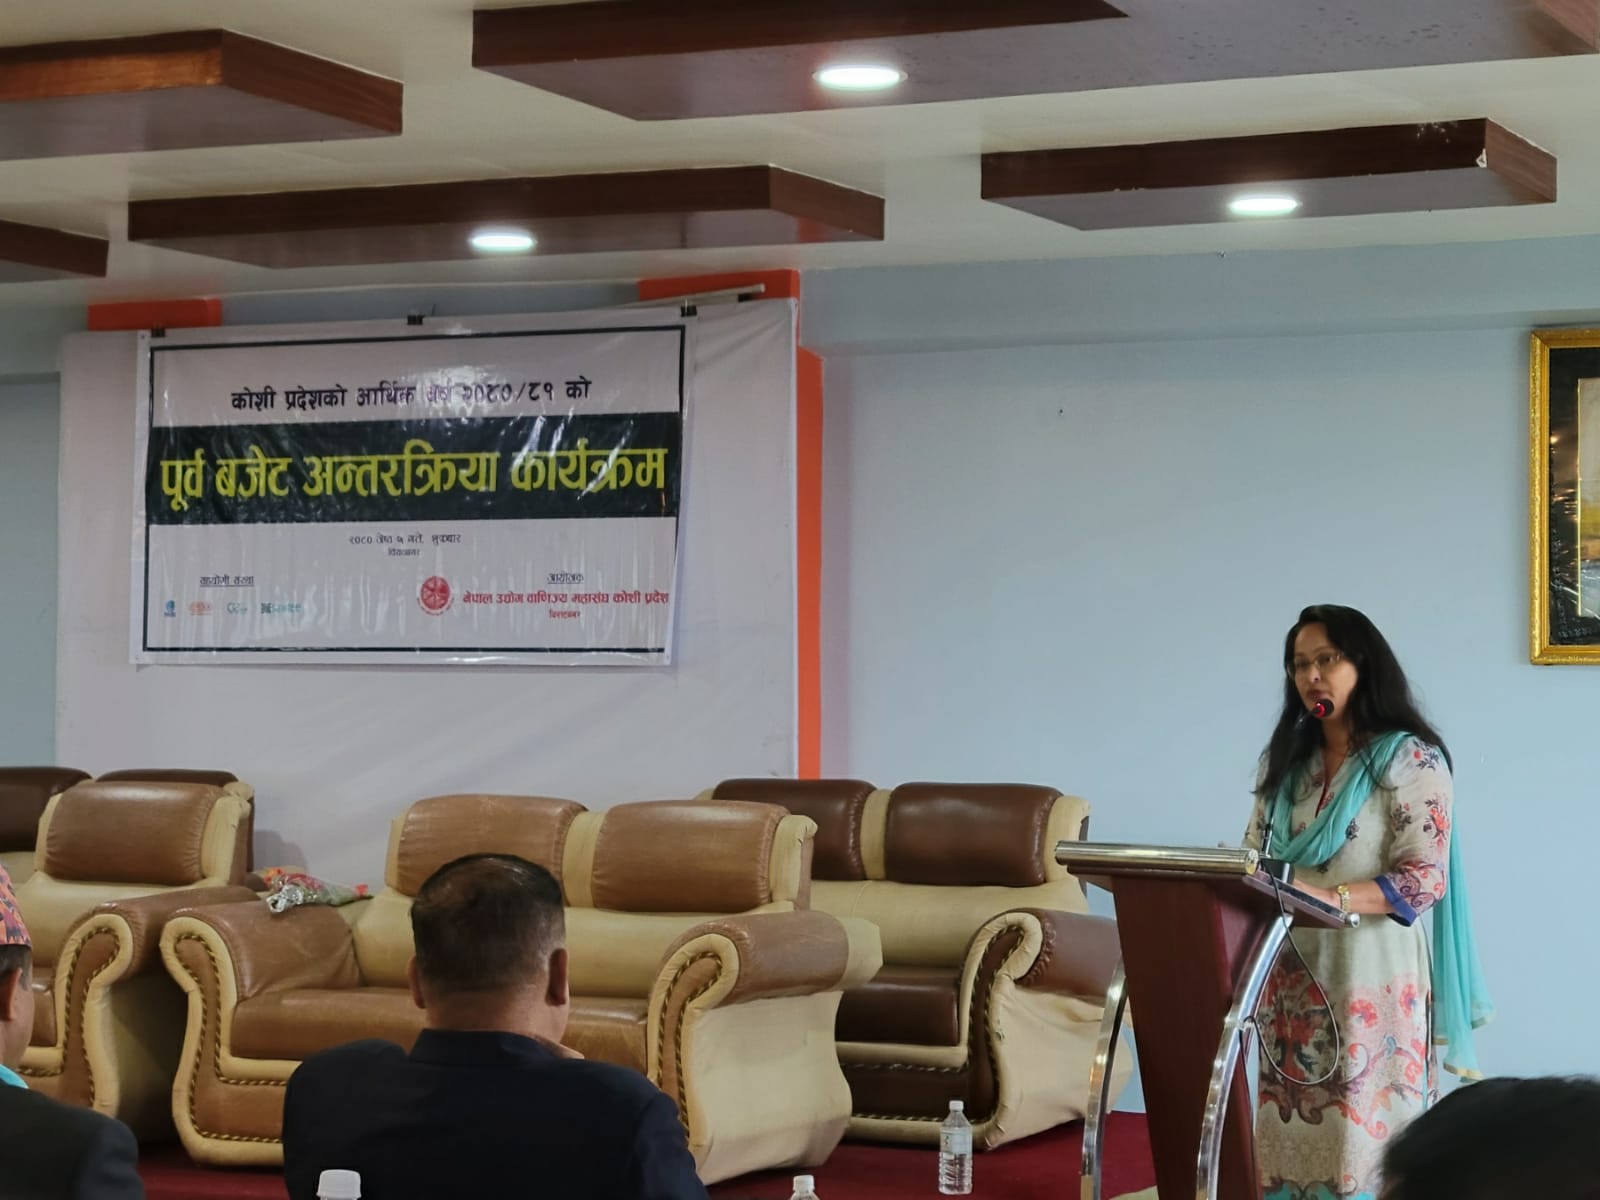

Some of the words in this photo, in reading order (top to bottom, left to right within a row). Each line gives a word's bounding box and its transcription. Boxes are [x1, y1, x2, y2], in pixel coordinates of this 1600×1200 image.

[231, 385, 276, 411] कोशी
[284, 384, 348, 411] प्रदेशको
[357, 380, 416, 406] आर्थिक
[565, 376, 592, 399] को
[160, 448, 206, 511] पूर्व
[215, 444, 292, 497] बजेट
[303, 439, 500, 496] अन्तरक्रिया
[511, 438, 668, 493] कार्यक्रम
[463, 590, 493, 604] नेपाल
[571, 592, 609, 604] महासंघ
[612, 590, 641, 604] कोशी
[645, 589, 669, 604] प्रदेश
